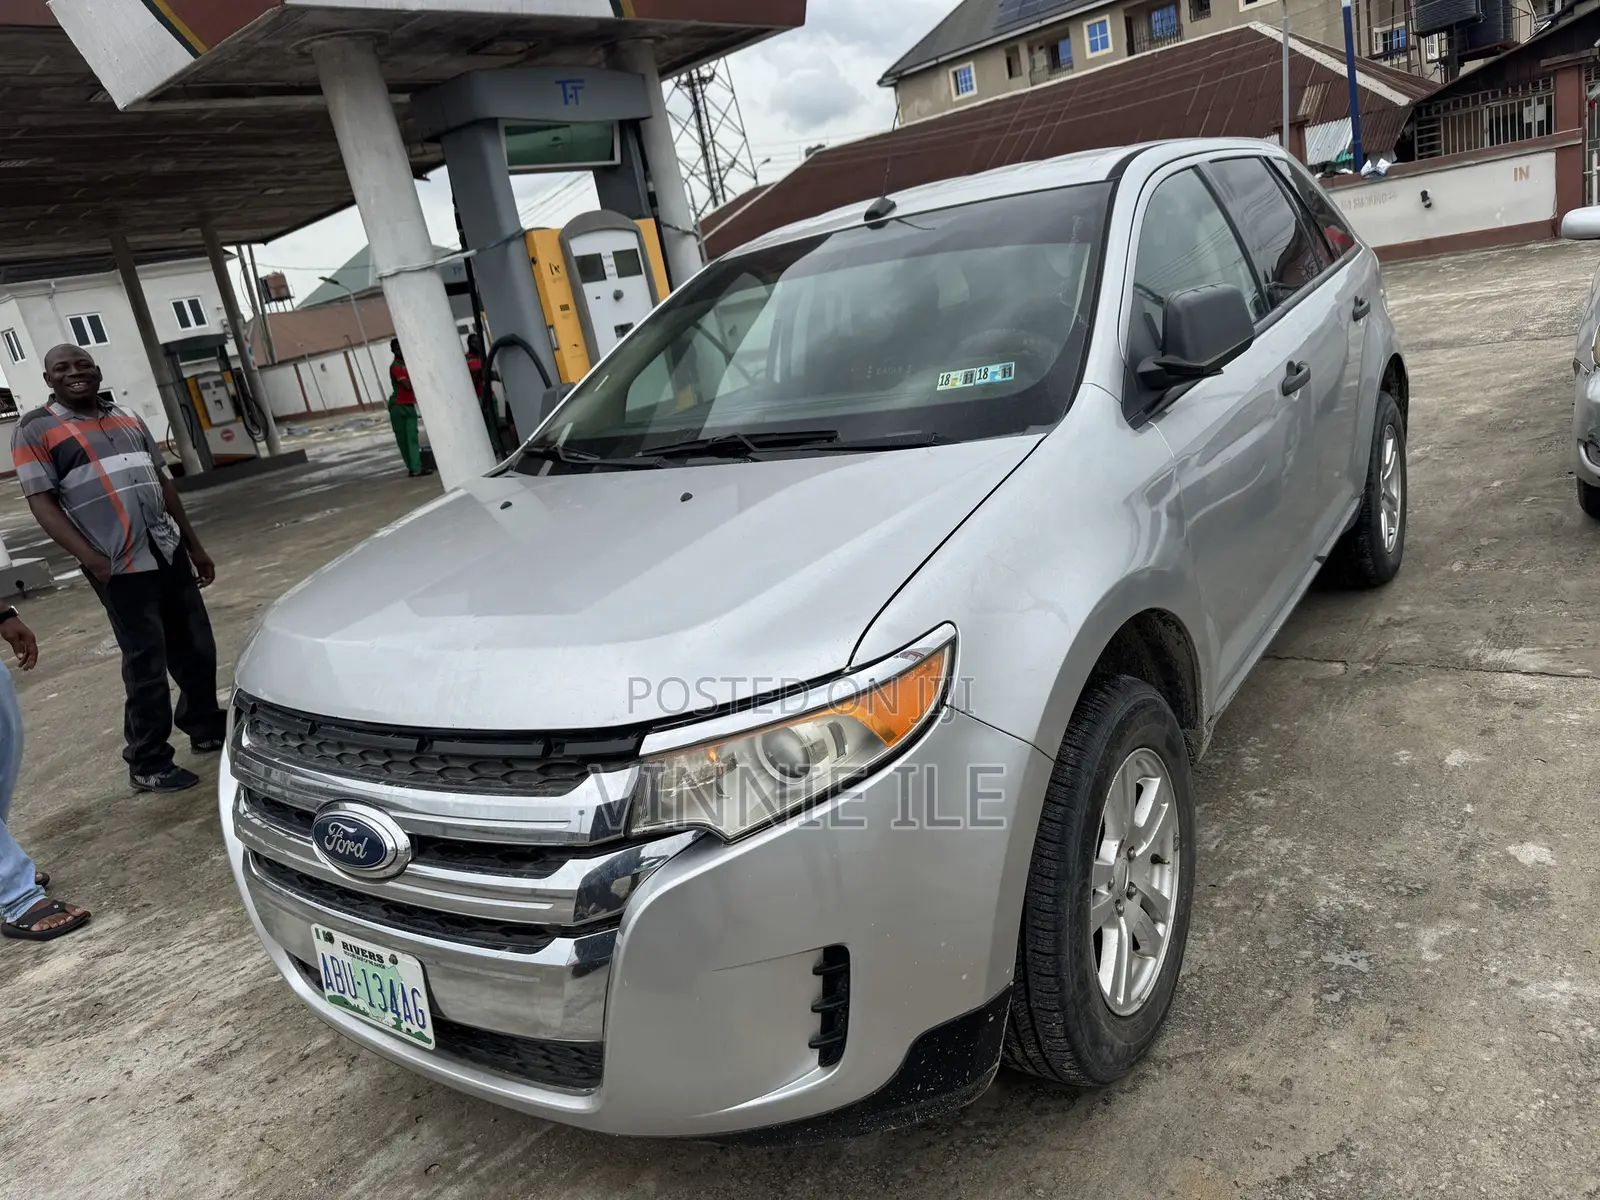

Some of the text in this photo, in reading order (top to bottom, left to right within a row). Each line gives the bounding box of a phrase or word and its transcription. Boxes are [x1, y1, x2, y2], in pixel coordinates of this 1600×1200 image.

[1513, 165, 1530, 182] IN
[939, 373, 951, 387] 18
[977, 367, 989, 381] 18
[324, 821, 367, 860] Ford
[341, 940, 385, 964] RIVERS
[321, 951, 427, 1030] ABU-134AG
